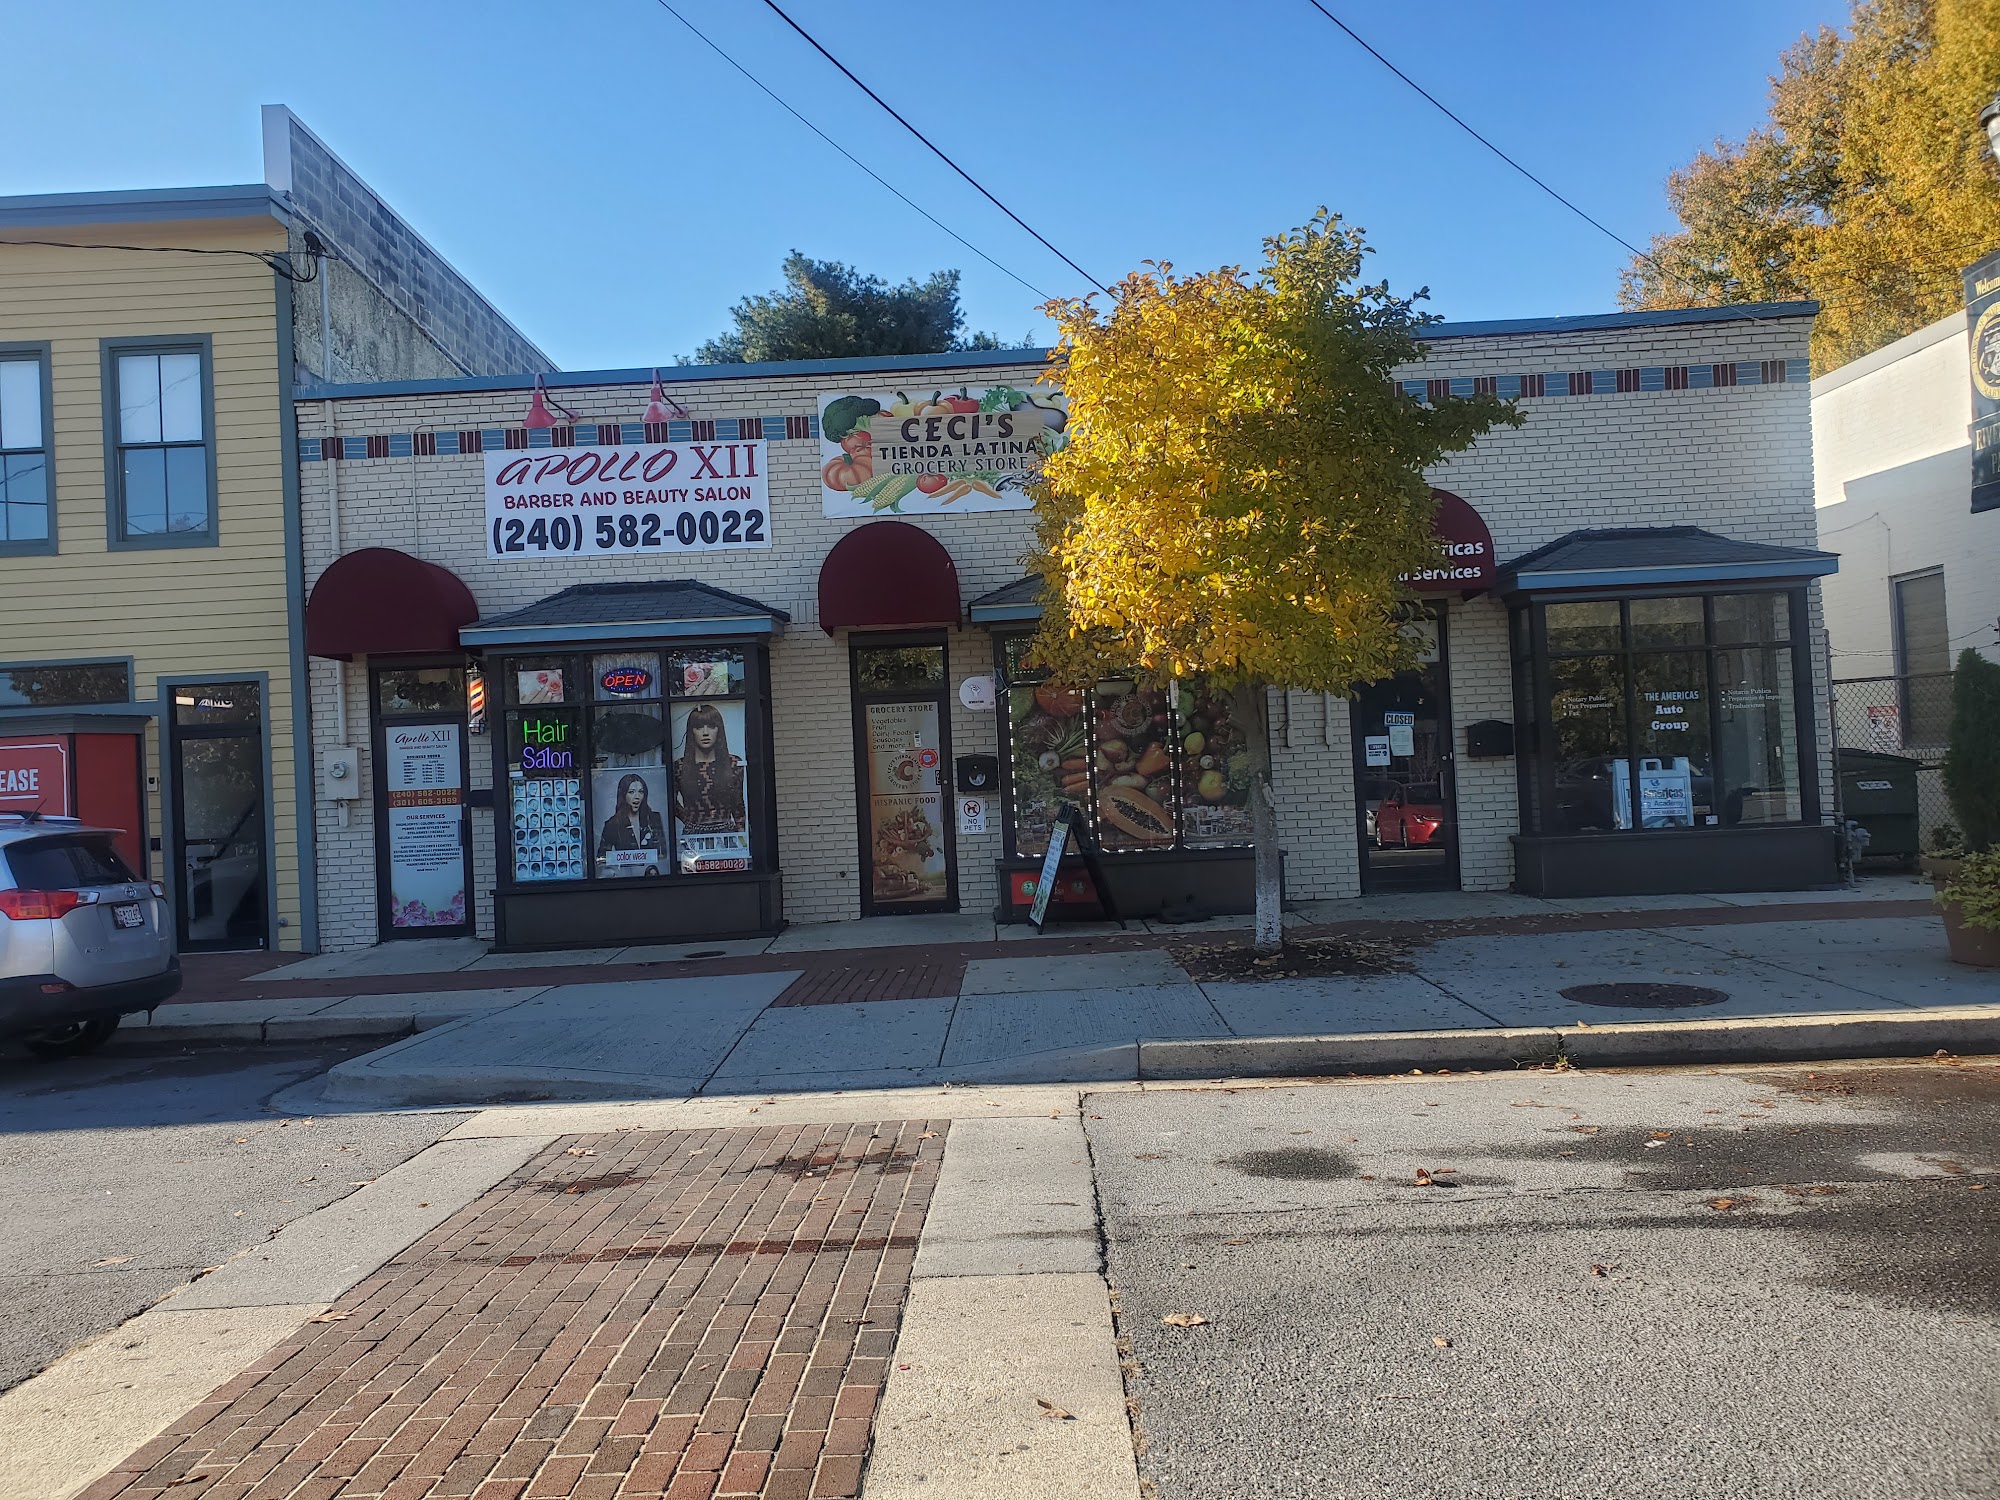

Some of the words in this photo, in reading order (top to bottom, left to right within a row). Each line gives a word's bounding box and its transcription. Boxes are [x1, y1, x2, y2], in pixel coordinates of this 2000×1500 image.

[901, 413, 1014, 442] CECI'S
[879, 442, 953, 460] TIENDA
[963, 439, 1038, 456] LATINA
[690, 444, 759, 480] XII
[891, 459, 968, 475] GROCERY
[976, 456, 1029, 471] STORE
[504, 492, 574, 510] BARBER
[580, 491, 617, 507] AND
[623, 488, 688, 505] BEAUTY
[695, 486, 751, 502] SALON
[493, 514, 583, 554] (240)
[596, 509, 765, 548] 582-0022
[1431, 542, 1485, 556] ricas
[1412, 566, 1482, 581] Services
[605, 674, 646, 688] OPEN
[1644, 692, 1660, 701] THE
[1660, 690, 1699, 701] AMERICAS
[870, 705, 906, 714] GROCERY
[908, 704, 934, 712] STORE
[1655, 704, 1684, 715] Auto
[871, 717, 907, 726] Vegetables
[1386, 714, 1413, 725] CLOSED
[1651, 720, 1690, 731] Group
[523, 719, 568, 743] Hair
[872, 724, 887, 732] Fruit
[431, 730, 451, 742] XII
[522, 747, 572, 769] Salon
[392, 791, 415, 799] (240)
[417, 789, 457, 798] 582-0022
[1644, 787, 1684, 798] Americas
[392, 799, 415, 807] (301)
[417, 797, 457, 806] 605-3999
[874, 798, 912, 807] HISPANIC
[914, 797, 936, 805] FOOD
[616, 851, 631, 862] color
[632, 852, 648, 860] wear
[685, 859, 744, 872] 0.582.0022
